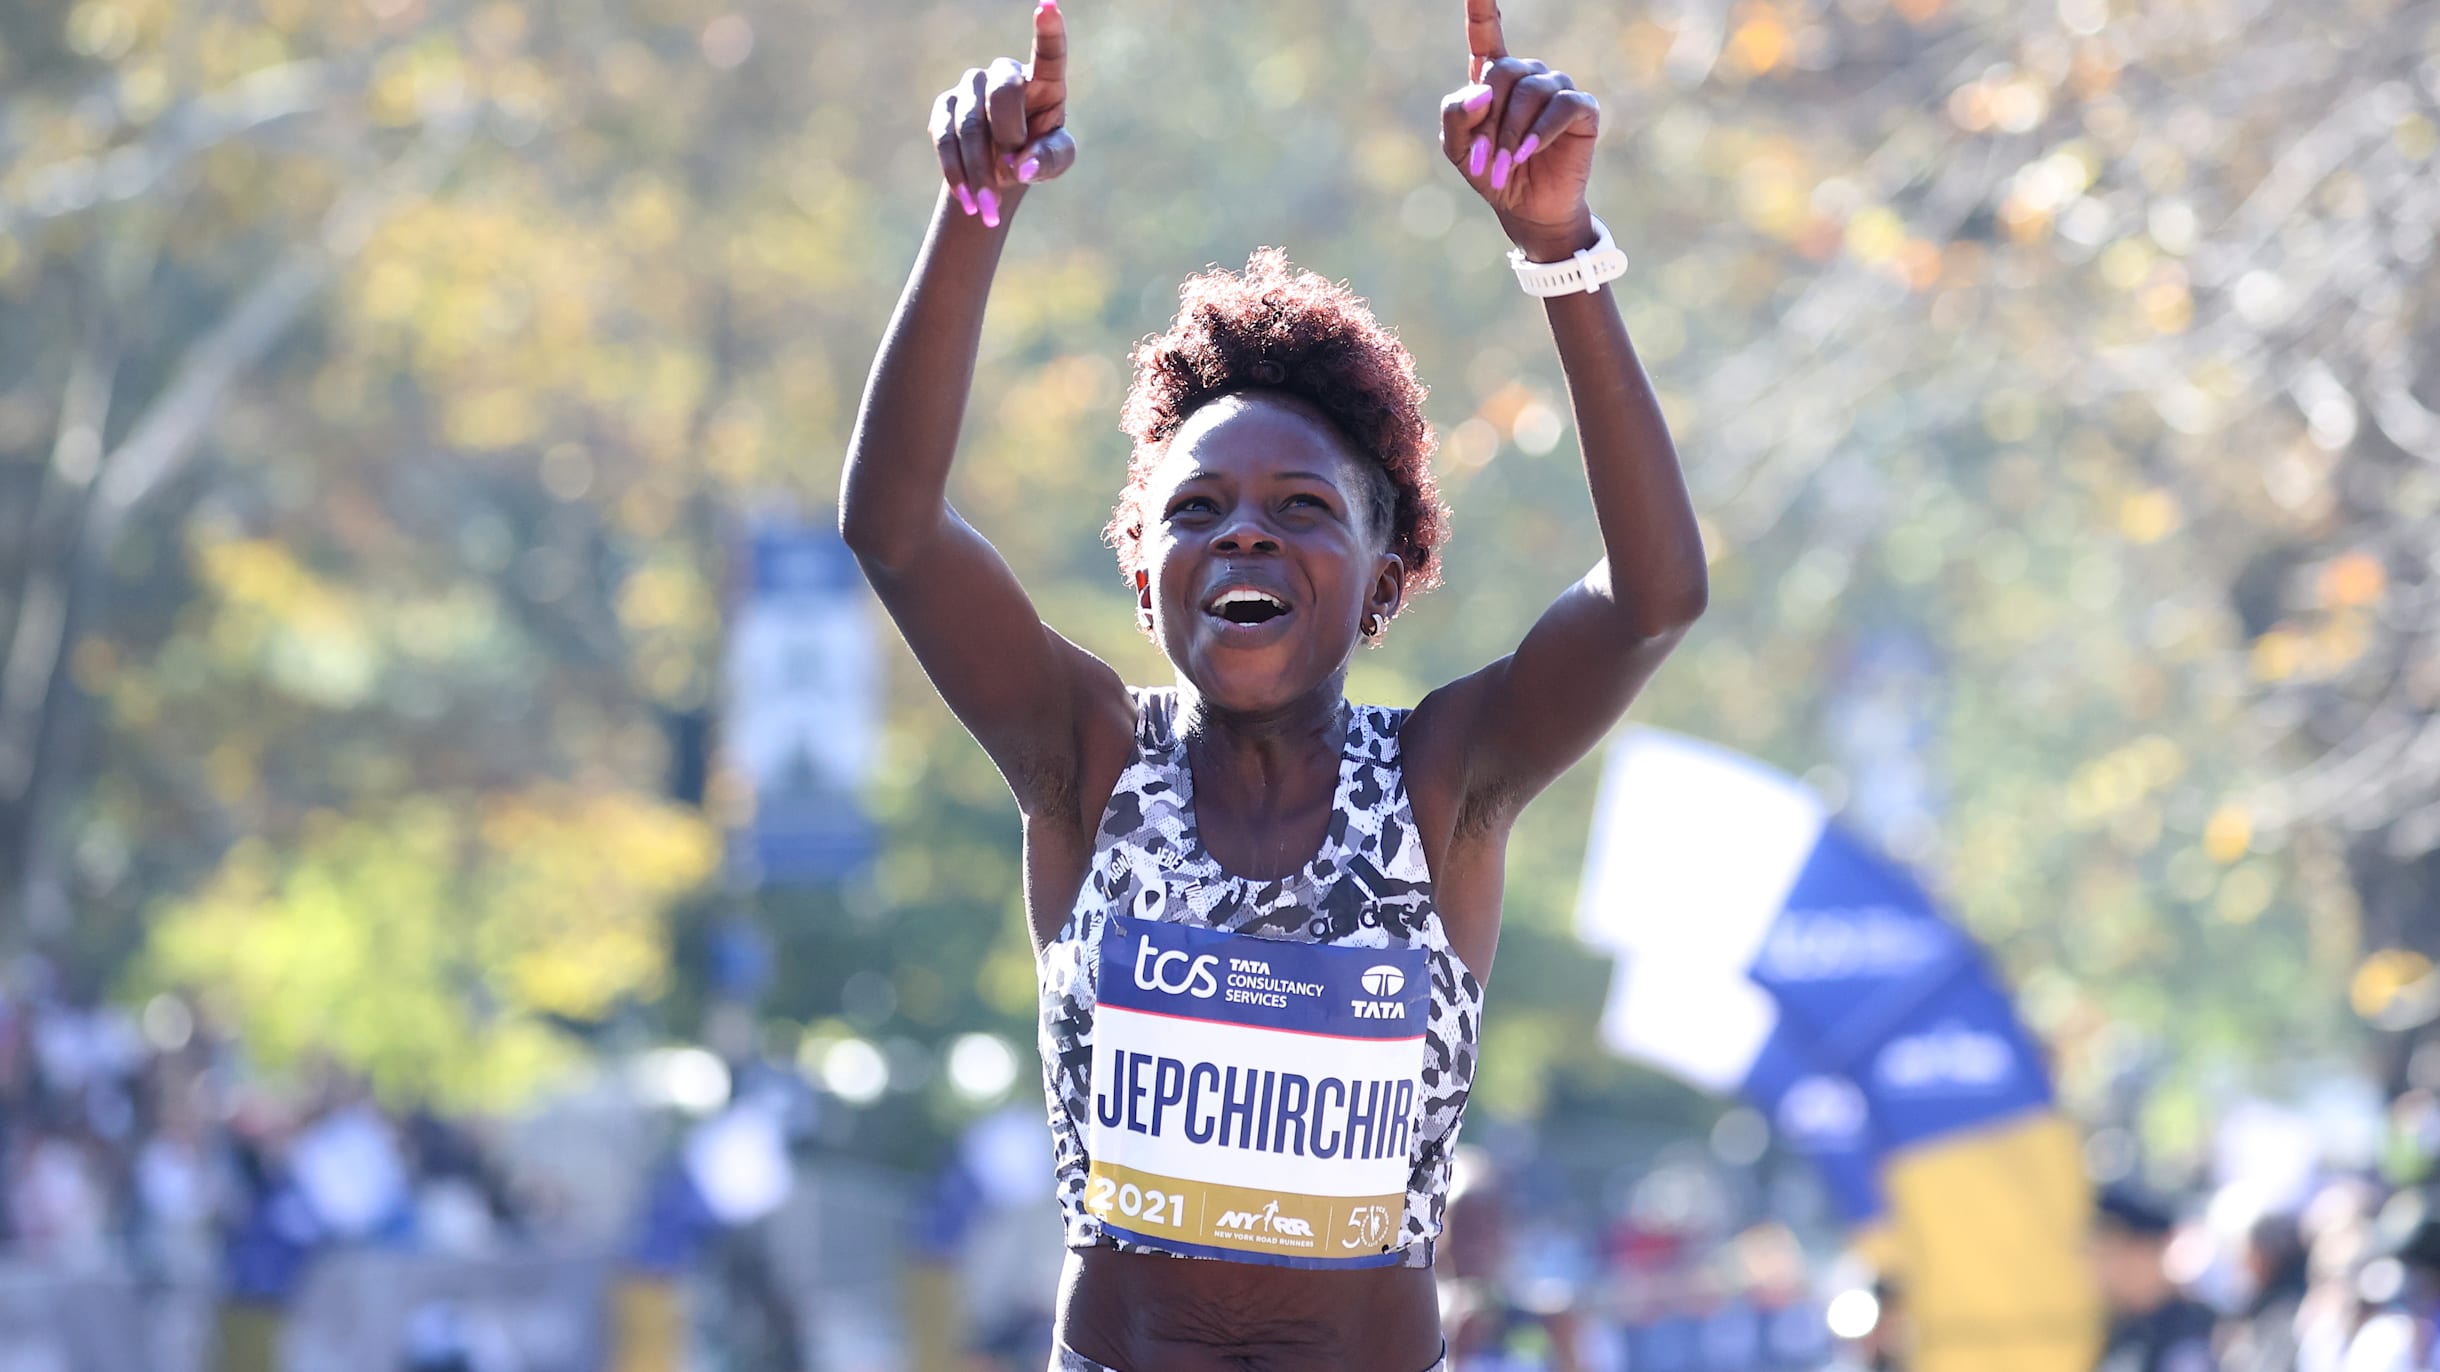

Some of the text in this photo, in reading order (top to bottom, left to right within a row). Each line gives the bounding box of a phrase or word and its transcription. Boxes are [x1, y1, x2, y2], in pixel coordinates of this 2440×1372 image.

[1135, 934, 1219, 998] tcs
[1229, 958, 1270, 975] TATA
[1227, 974, 1324, 997] CONSULTANCY
[1225, 989, 1287, 1008] SERVICES
[1351, 1000, 1405, 1019] TATA
[1097, 1049, 1414, 1160] JEPCHIRCHIR
[1088, 1176, 1185, 1228] 2021
[1214, 1230, 1314, 1248] NEW YORK ROAD RUNNERS
